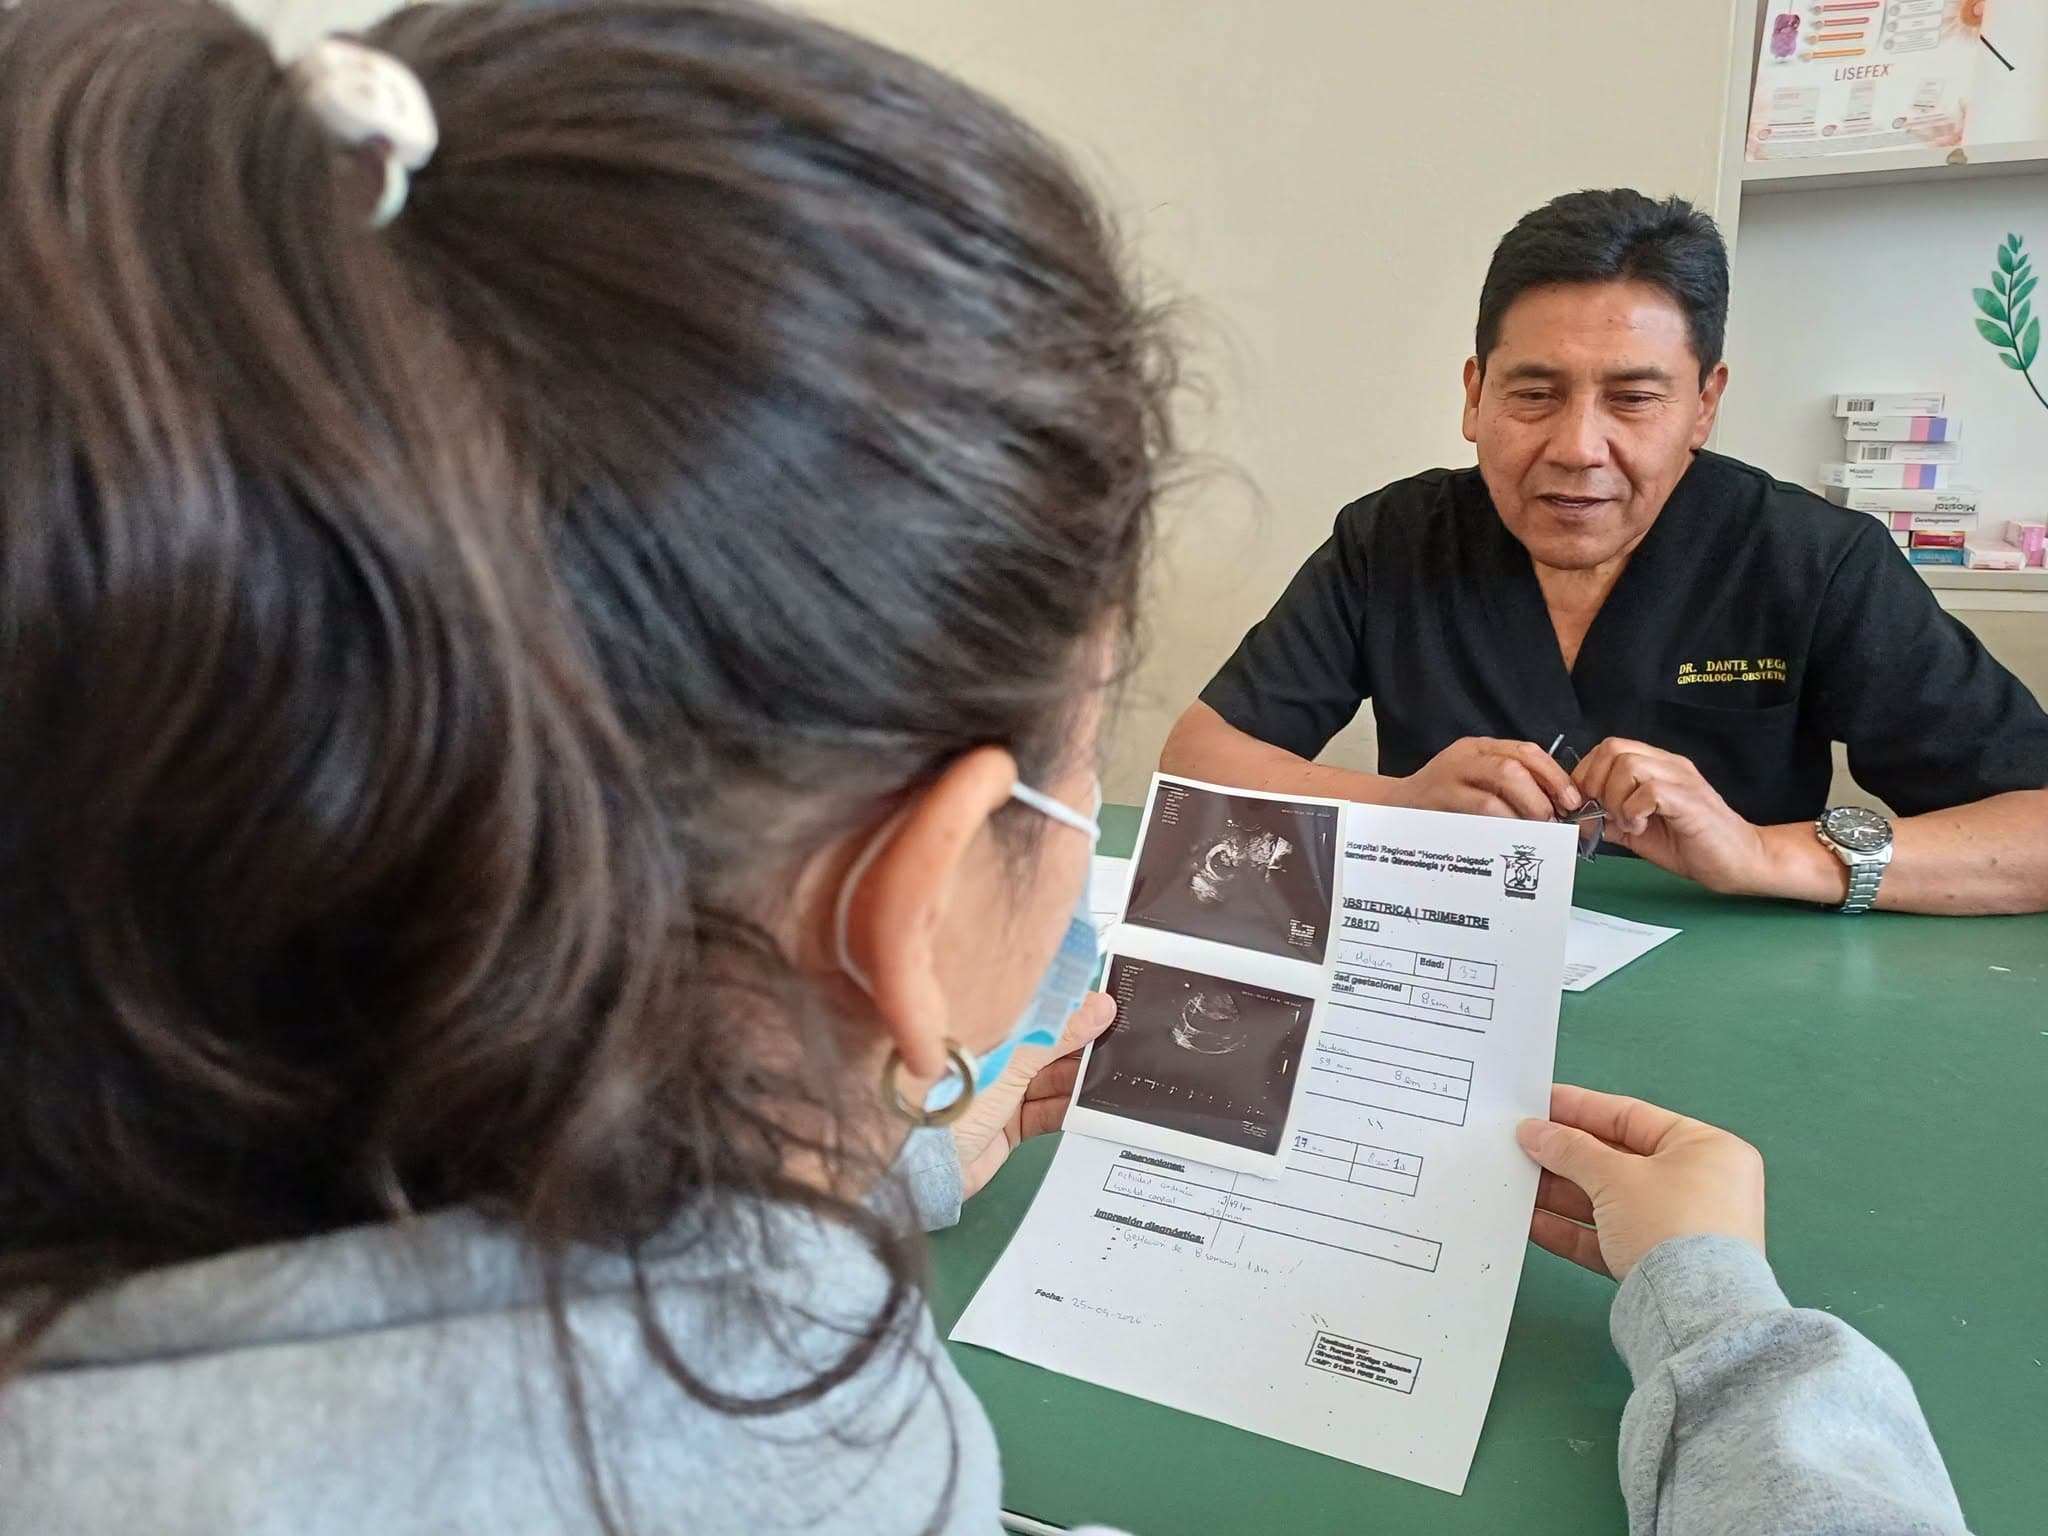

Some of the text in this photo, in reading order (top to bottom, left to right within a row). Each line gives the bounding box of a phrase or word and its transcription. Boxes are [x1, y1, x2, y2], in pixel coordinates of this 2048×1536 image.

[1834, 63, 1890, 81] LISEFEX
[1934, 502, 1976, 512] Miositol
[1679, 658, 1786, 675] DR. DANTE VEGA
[1346, 841, 1494, 866] Hospital Regional "Honorio Delgado"
[1380, 855, 1389, 863] de
[1440, 864, 1446, 872] y
[1421, 908, 1490, 930] TRIMESTRE
[1419, 957, 1444, 969] Edad:
[1351, 977, 1402, 992] gestacional
[1294, 1136, 1308, 1148] 17
[1119, 1150, 1184, 1172] Observaciones:
[1094, 1208, 1205, 1244] Impresión diagnóstica:
[1034, 1288, 1064, 1302] Fecha:
